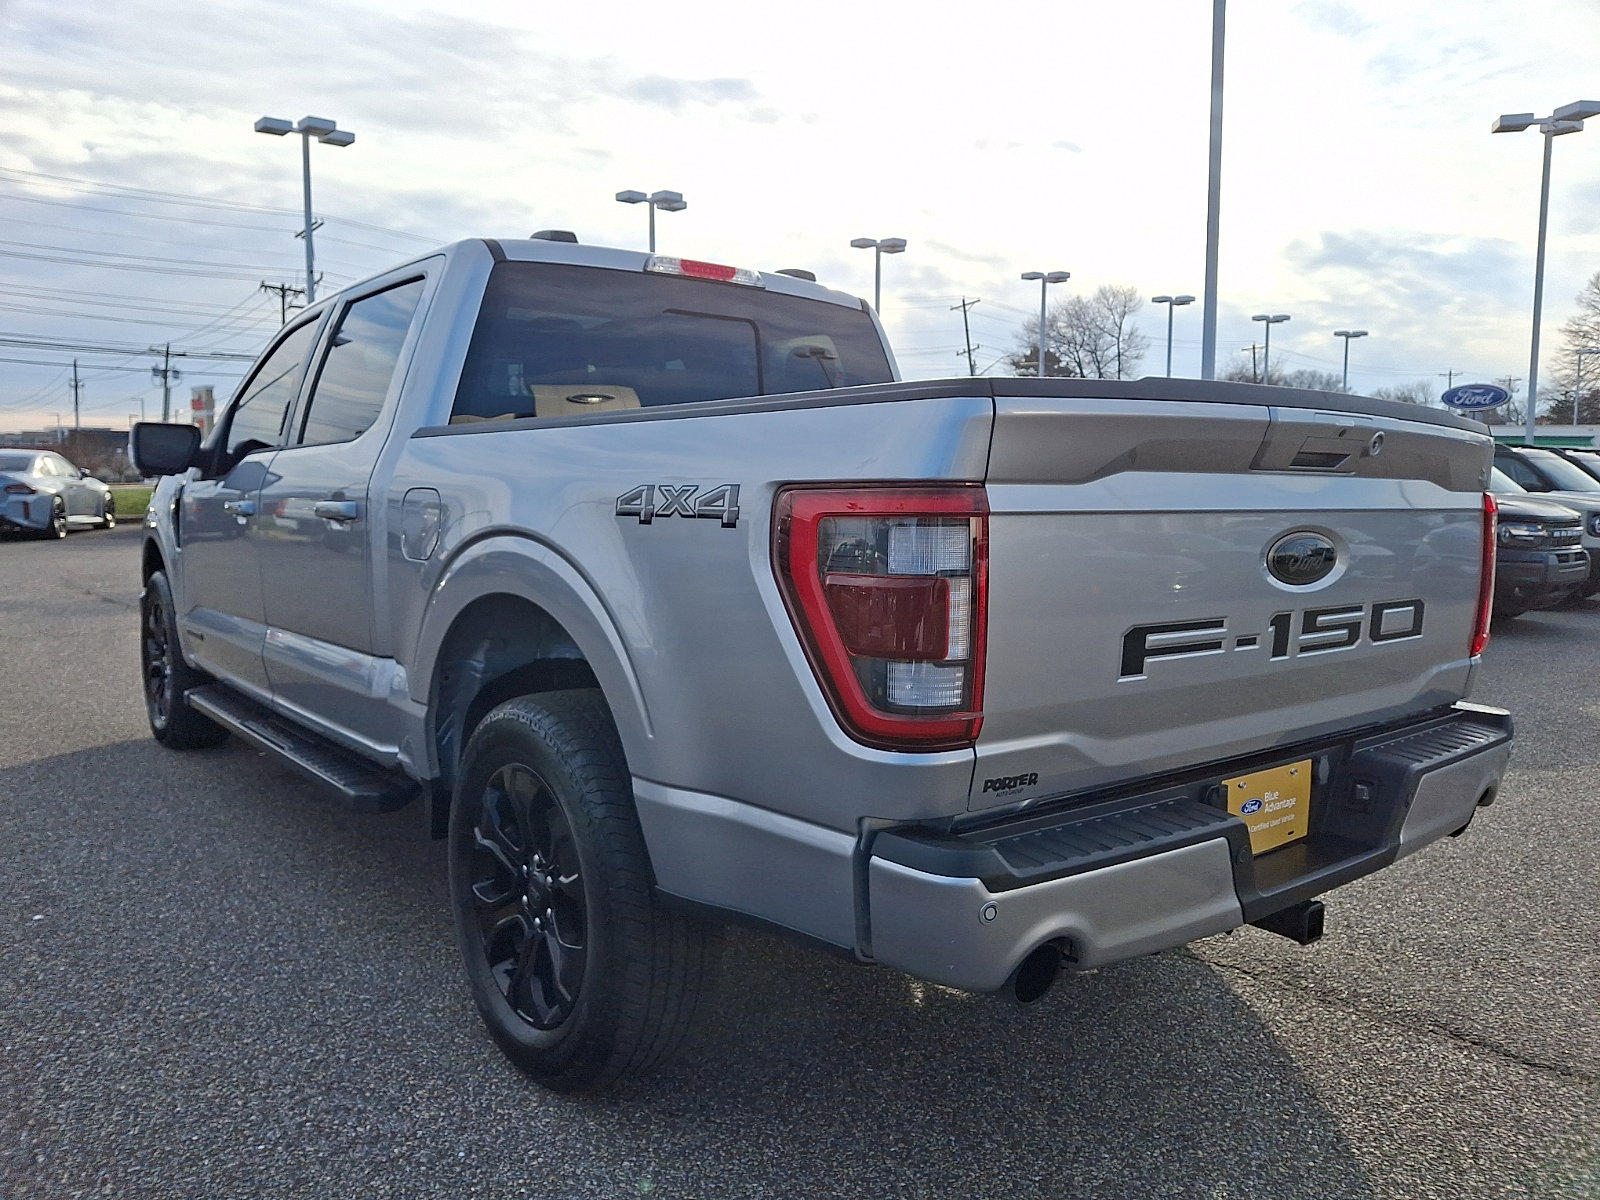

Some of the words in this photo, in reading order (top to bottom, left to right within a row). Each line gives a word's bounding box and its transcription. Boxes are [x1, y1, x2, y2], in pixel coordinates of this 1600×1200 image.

[1454, 388, 1496, 405] Ford
[615, 483, 741, 529] 4X4
[1289, 543, 1327, 573] Ford
[1116, 598, 1426, 683] F-150
[982, 772, 1039, 793] PORTER
[1264, 791, 1280, 802] Blue
[1264, 797, 1297, 813] Advantage
[1243, 800, 1260, 813] Ford
[1251, 821, 1269, 832] Certified
